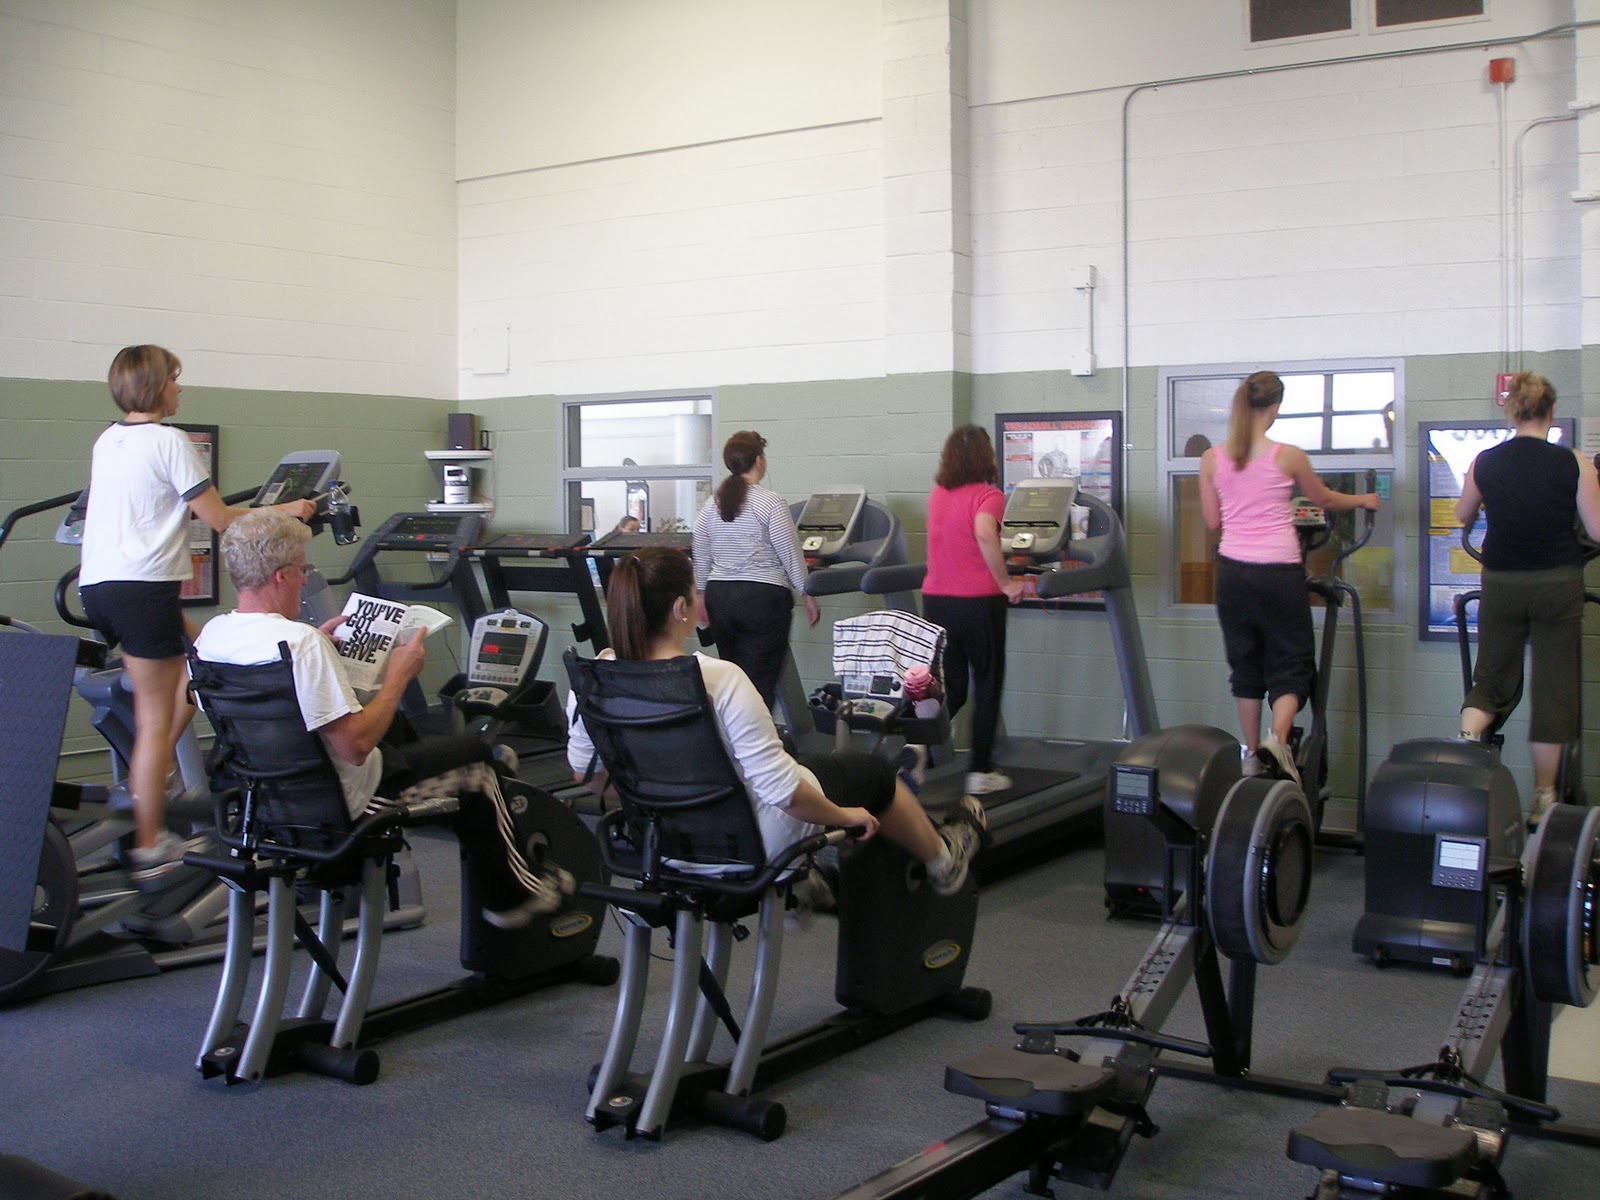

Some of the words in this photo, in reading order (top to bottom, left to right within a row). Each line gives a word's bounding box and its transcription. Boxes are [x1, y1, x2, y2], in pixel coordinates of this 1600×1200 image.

[346, 613, 375, 632] GOT
[357, 599, 405, 625] YOU'VE
[350, 629, 392, 652] SOME
